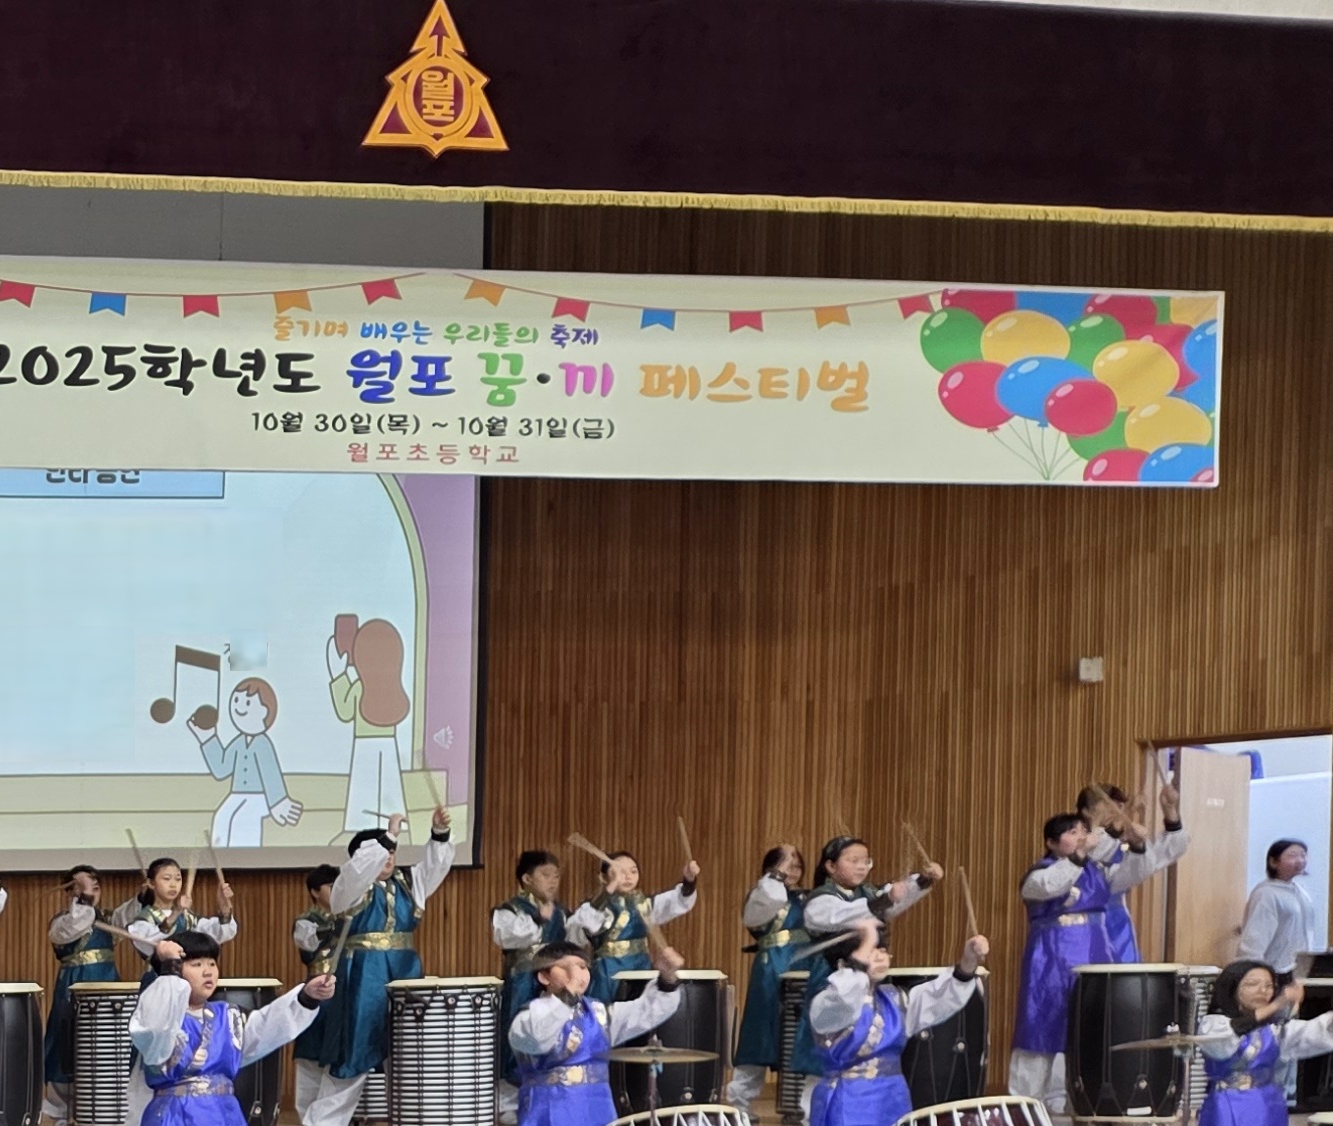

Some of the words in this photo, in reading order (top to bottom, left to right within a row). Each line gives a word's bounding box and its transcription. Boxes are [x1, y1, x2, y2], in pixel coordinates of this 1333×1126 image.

[273, 316, 349, 342] 즐기며
[359, 320, 434, 345] 배우는
[442, 322, 540, 348] 우리들의
[549, 324, 600, 349] 축제
[345, 349, 456, 405] 월포
[638, 359, 870, 413] 페스티벌
[250, 411, 304, 433] 10월
[313, 413, 422, 436] 30일(목)
[457, 416, 509, 438] 10월
[518, 417, 616, 440] 31일(금)
[346, 442, 520, 465] 월포초등학교
